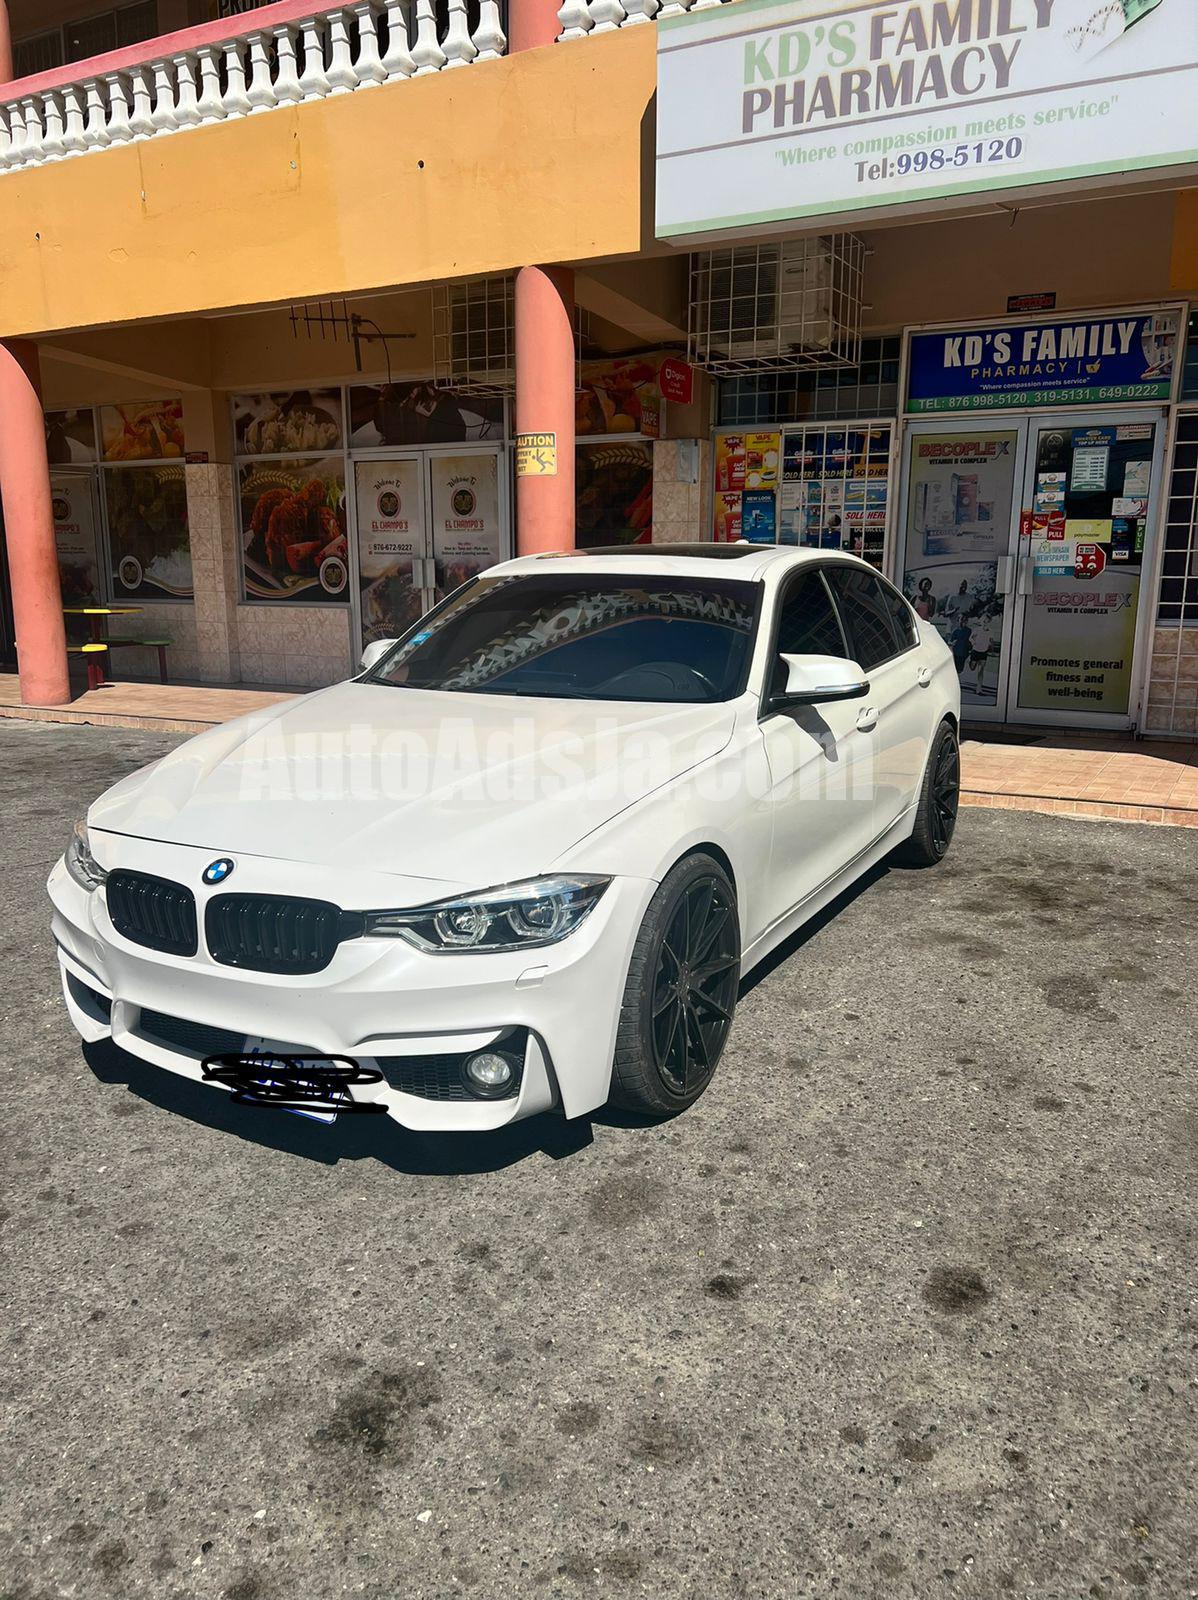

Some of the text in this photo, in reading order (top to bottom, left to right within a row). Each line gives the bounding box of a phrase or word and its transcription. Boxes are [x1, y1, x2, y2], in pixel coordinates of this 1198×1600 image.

[743, 0, 1055, 85] KD'S FAMILY
[742, 38, 1024, 134] PHARMACY
[774, 95, 1120, 167] "Where compassion meets service"
[943, 321, 1137, 368] KD'S FAMILY
[971, 362, 1068, 379] PHARMACY
[1003, 381, 1041, 391] compassion
[1042, 379, 1062, 388] meets
[919, 399, 945, 410] TEL:
[948, 396, 969, 408] 876
[1099, 385, 1159, 398] 649-0222
[517, 436, 554, 447] AUTION
[918, 441, 1009, 460] BECOPLEX
[855, 468, 888, 477] SOD HER
[1052, 567, 1066, 575] HERE
[1033, 591, 1132, 613] BECOPLEX
[1080, 607, 1109, 615] COMPLEX
[1030, 656, 1124, 670] Promotes general
[1046, 671, 1105, 684] fitness and
[1048, 687, 1104, 700] well-being
